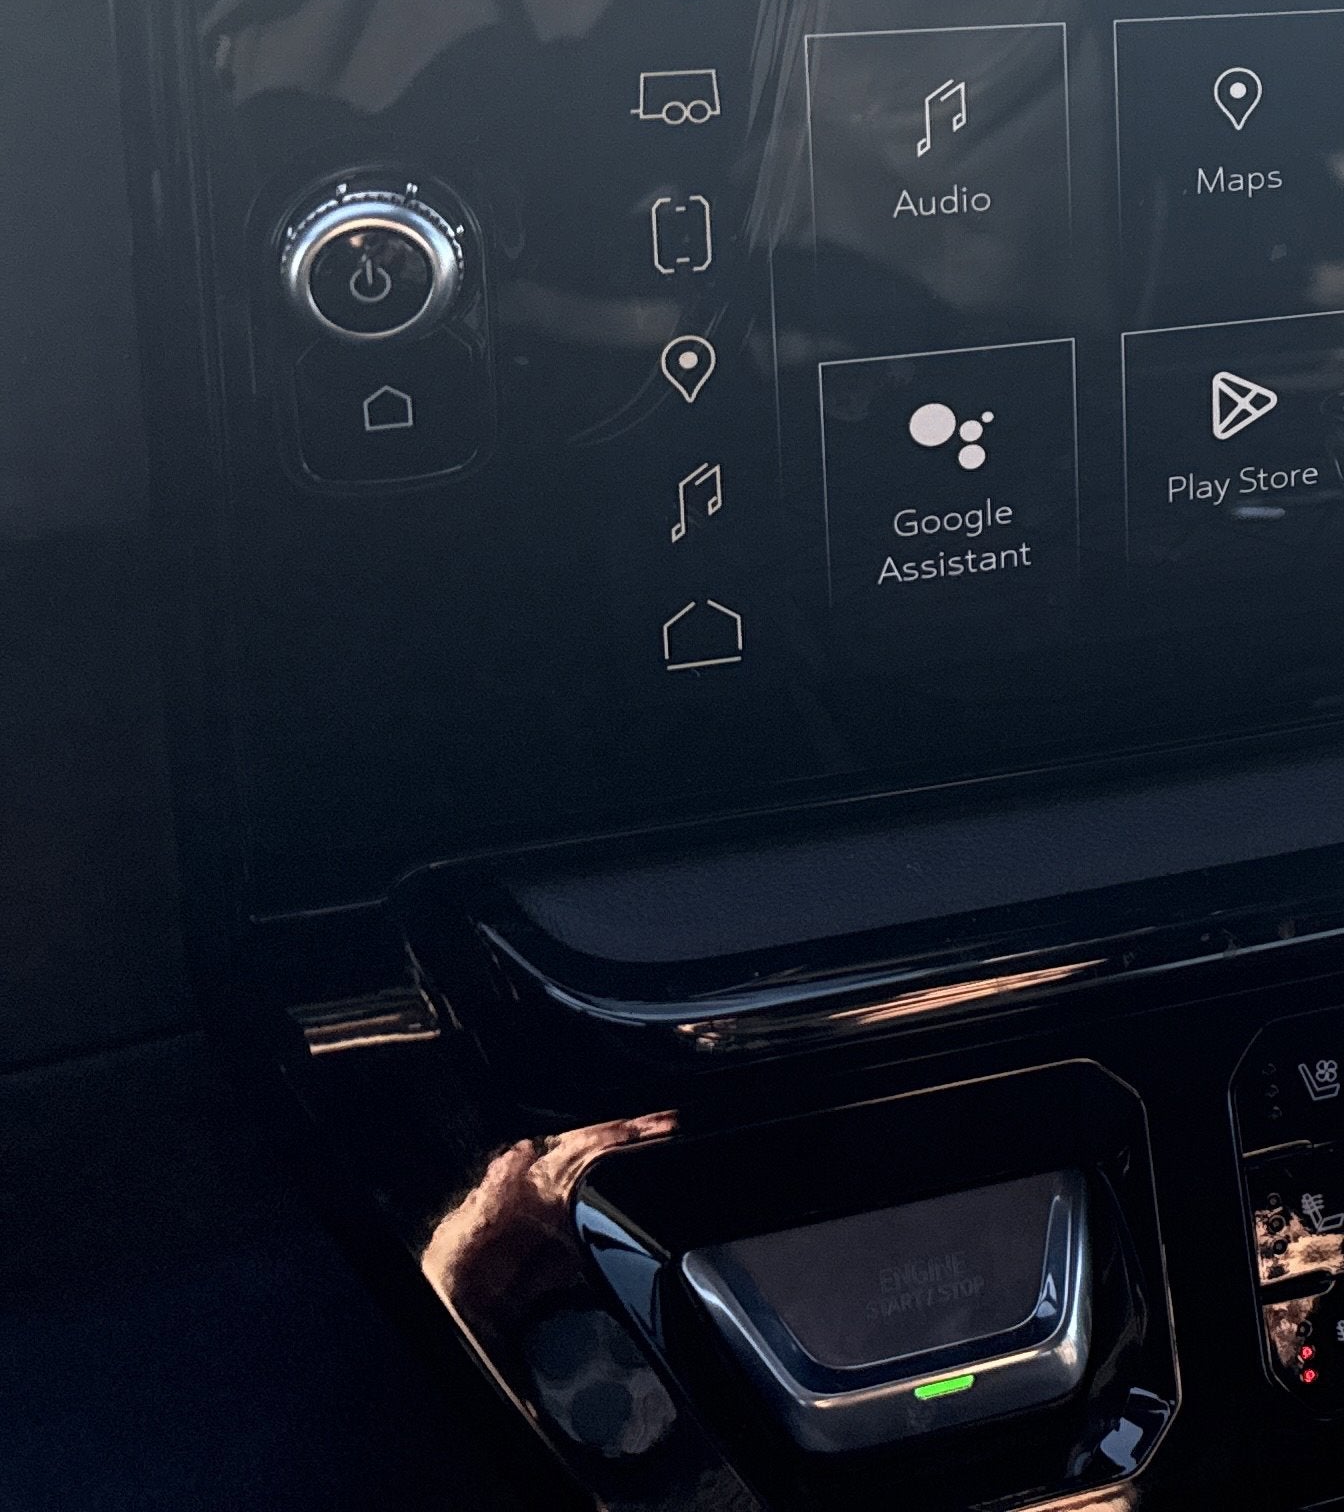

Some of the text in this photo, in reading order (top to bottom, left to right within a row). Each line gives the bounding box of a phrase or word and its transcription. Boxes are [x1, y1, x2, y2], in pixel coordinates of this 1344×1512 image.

[893, 183, 992, 218] Audio
[1196, 165, 1283, 199] Maps
[1167, 463, 1319, 505] Play Store
[892, 497, 1014, 538] Google
[877, 542, 1032, 585] Assistant
